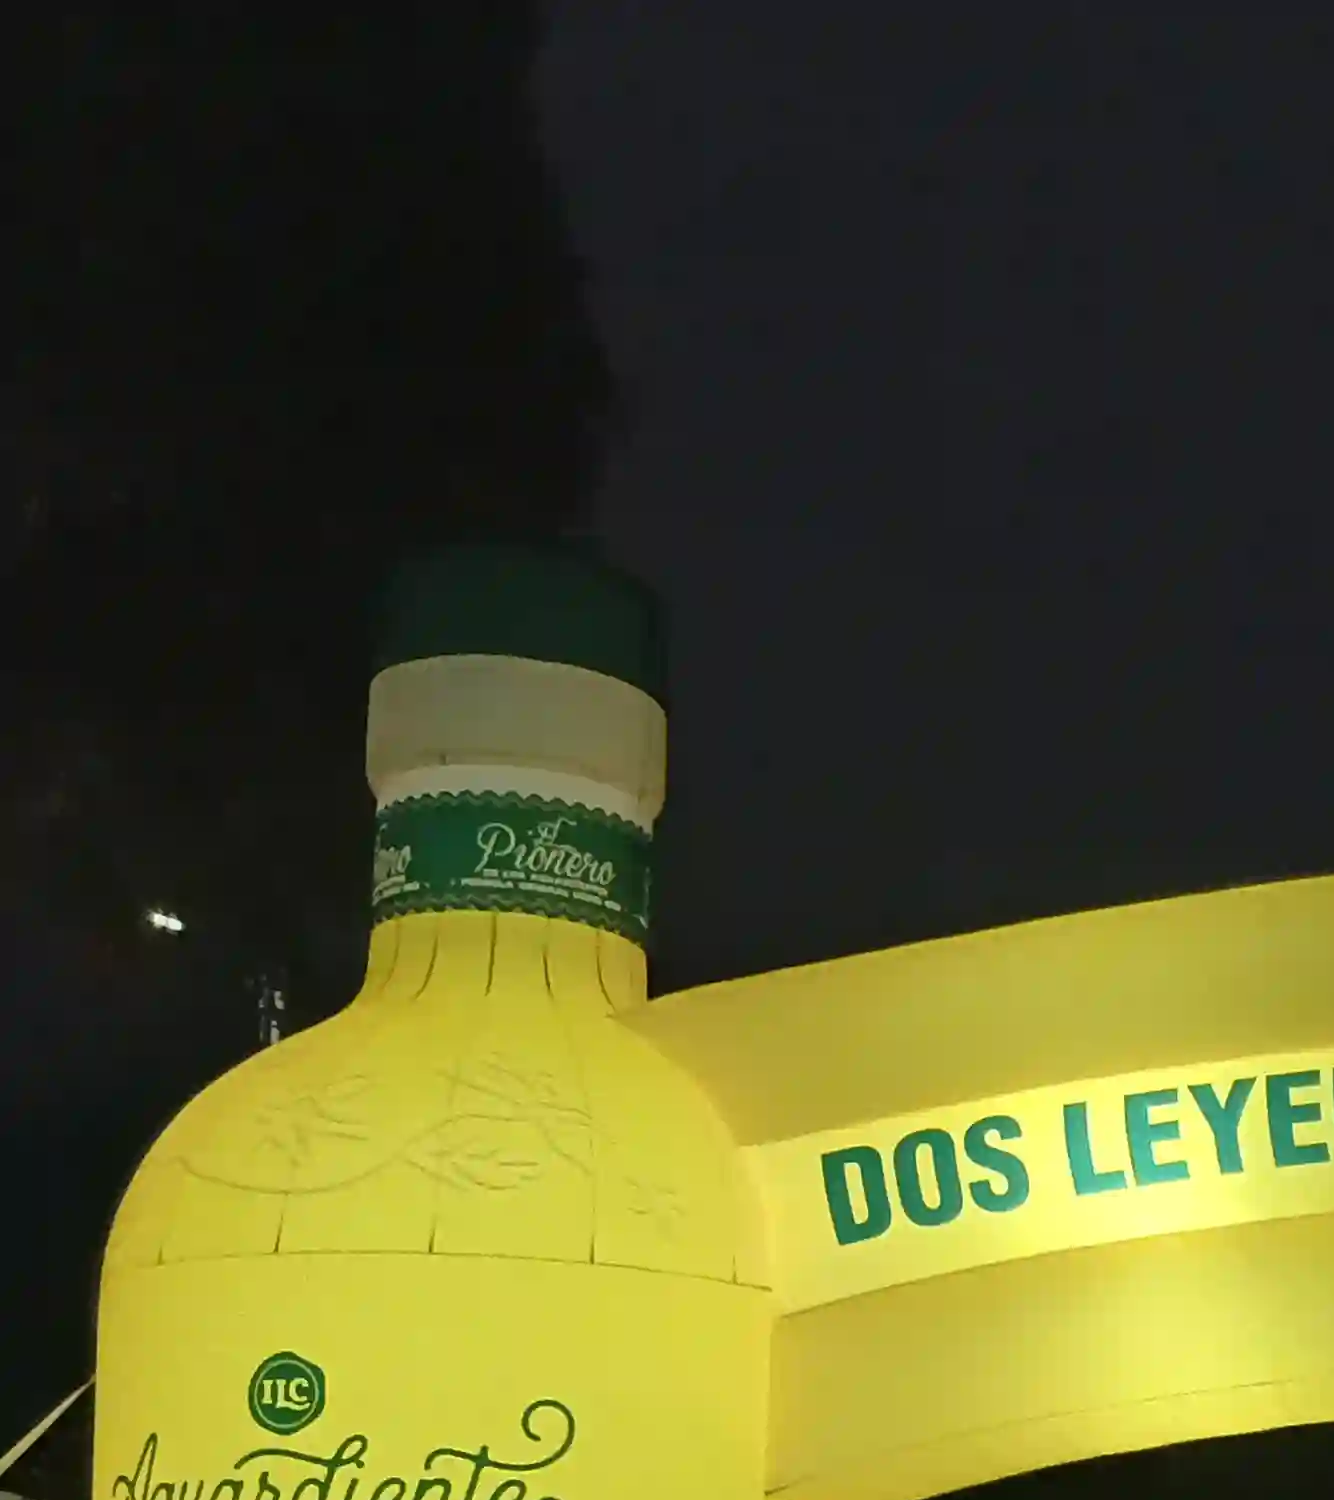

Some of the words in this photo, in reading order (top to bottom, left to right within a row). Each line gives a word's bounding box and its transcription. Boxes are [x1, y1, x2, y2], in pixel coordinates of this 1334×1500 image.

[474, 822, 616, 886] Pionero
[821, 1114, 1031, 1247] DOS
[263, 1377, 312, 1410] ILC
